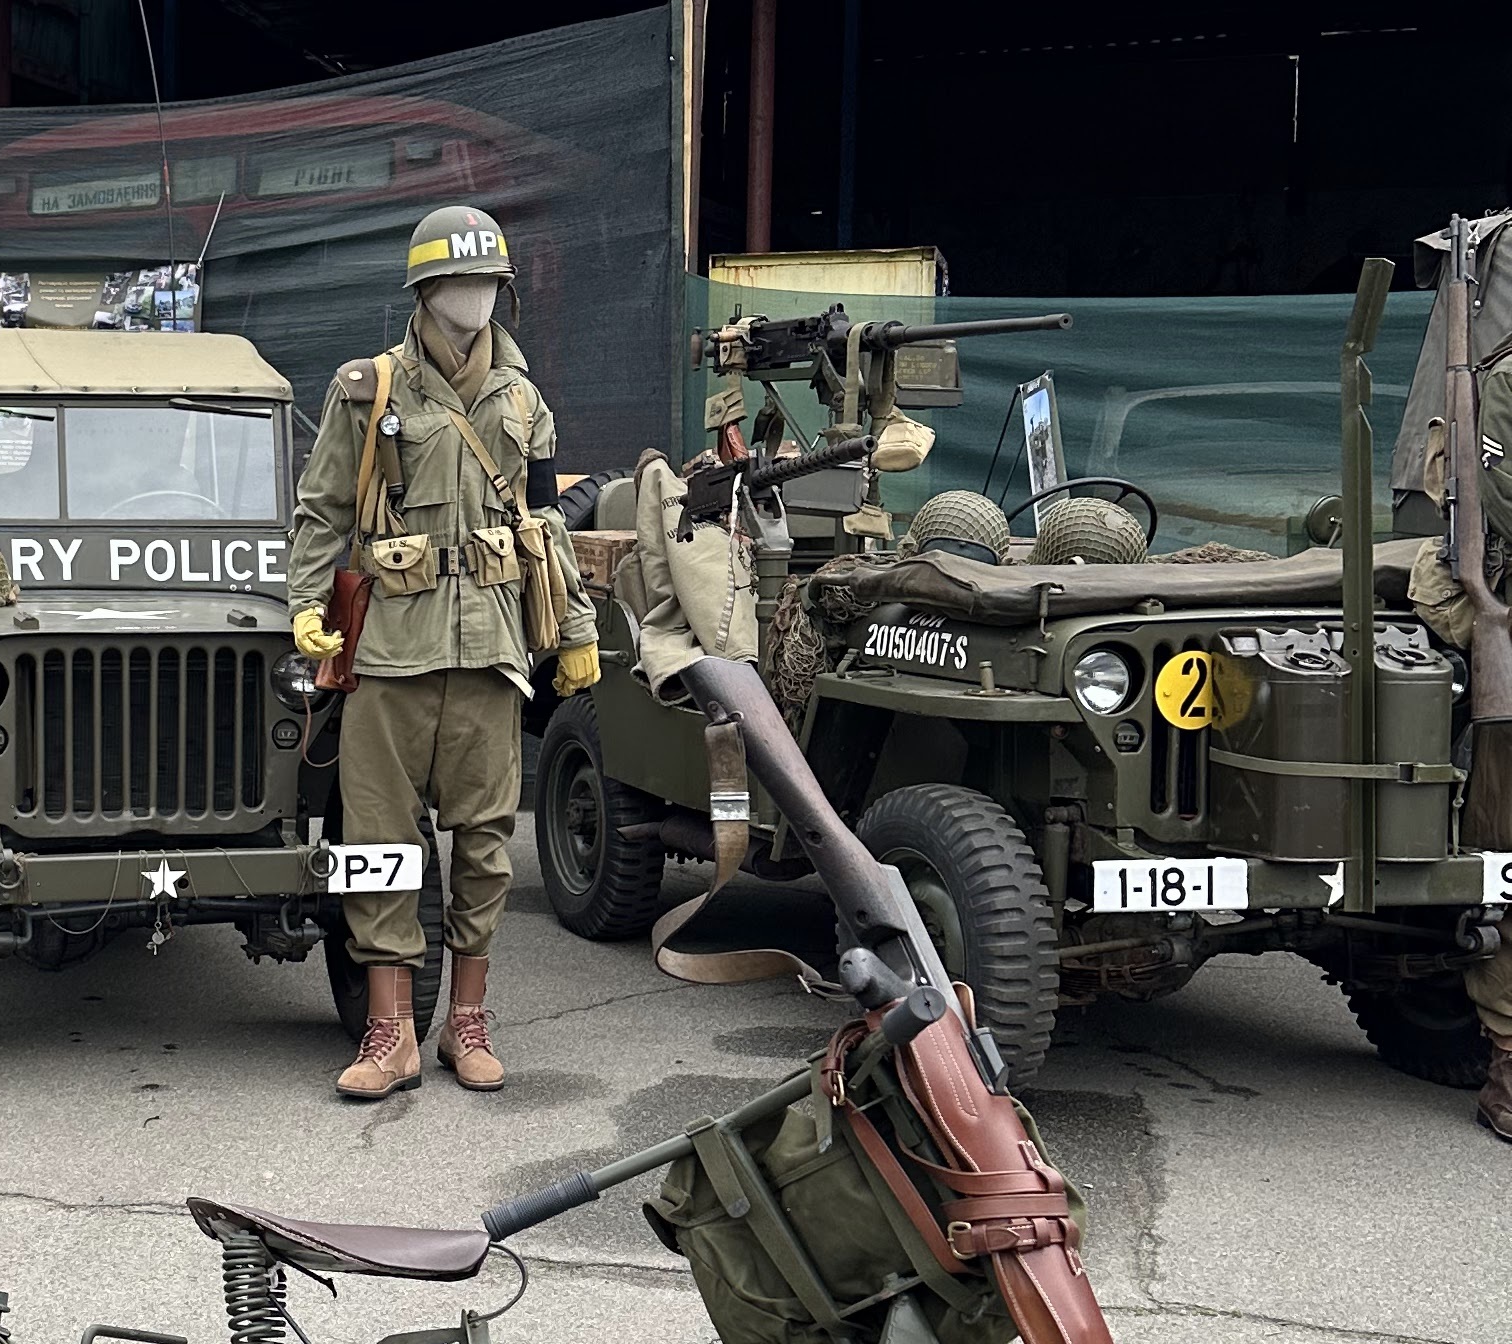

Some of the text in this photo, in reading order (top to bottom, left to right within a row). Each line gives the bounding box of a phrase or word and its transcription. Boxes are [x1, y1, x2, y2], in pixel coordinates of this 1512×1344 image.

[41, 197, 60, 212] НА
[451, 230, 497, 258] MP
[109, 539, 287, 583] POLICE
[864, 623, 968, 670] 20150407-S
[1180, 657, 1208, 717] 2
[345, 853, 404, 889] P-7
